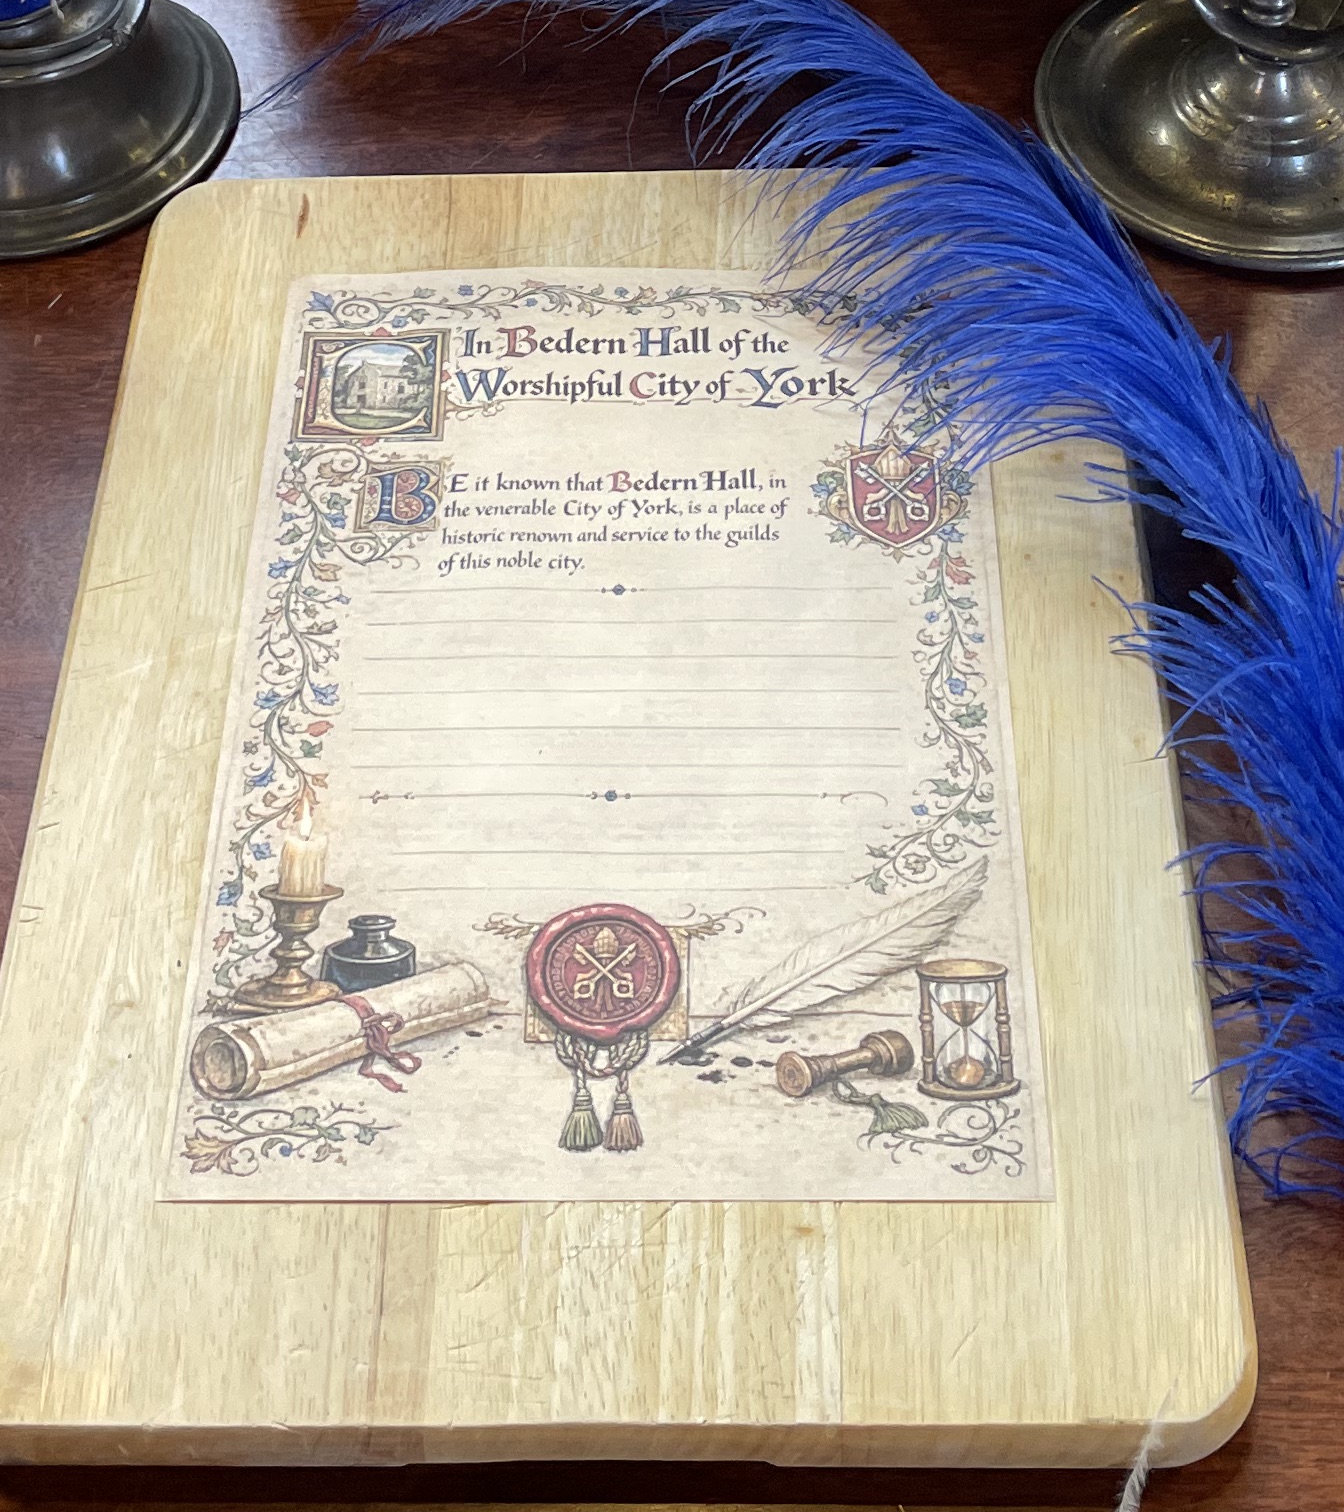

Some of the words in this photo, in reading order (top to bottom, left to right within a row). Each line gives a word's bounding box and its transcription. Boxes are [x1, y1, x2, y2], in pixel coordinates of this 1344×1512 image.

[460, 326, 493, 358] In
[497, 325, 626, 360] Bedern
[633, 326, 712, 357] Hall
[719, 328, 751, 360] of
[752, 333, 790, 354] the
[457, 365, 622, 403] Worshipful
[629, 371, 701, 406] City
[705, 370, 735, 403] of
[741, 367, 857, 409] York
[475, 476, 490, 492] it
[496, 471, 561, 491] known
[566, 471, 604, 492] that
[607, 469, 697, 493] Bedern
[698, 469, 764, 494] Hall,
[769, 478, 787, 489] in
[443, 499, 470, 518] the
[474, 497, 556, 516] venerable
[563, 499, 603, 522] City
[607, 498, 629, 521] of
[630, 497, 684, 519] York,
[688, 500, 702, 515] is
[707, 504, 718, 514] a
[724, 496, 766, 521] place
[769, 496, 790, 520] of
[441, 526, 505, 545] historic
[509, 531, 573, 543] renown
[576, 524, 608, 543] and
[611, 526, 669, 542] service
[673, 527, 691, 542] to
[694, 522, 722, 541] the
[724, 523, 780, 549] guilds
[437, 551, 460, 578] of
[459, 552, 491, 570] this
[496, 549, 543, 569] noble
[548, 552, 586, 576] city.
